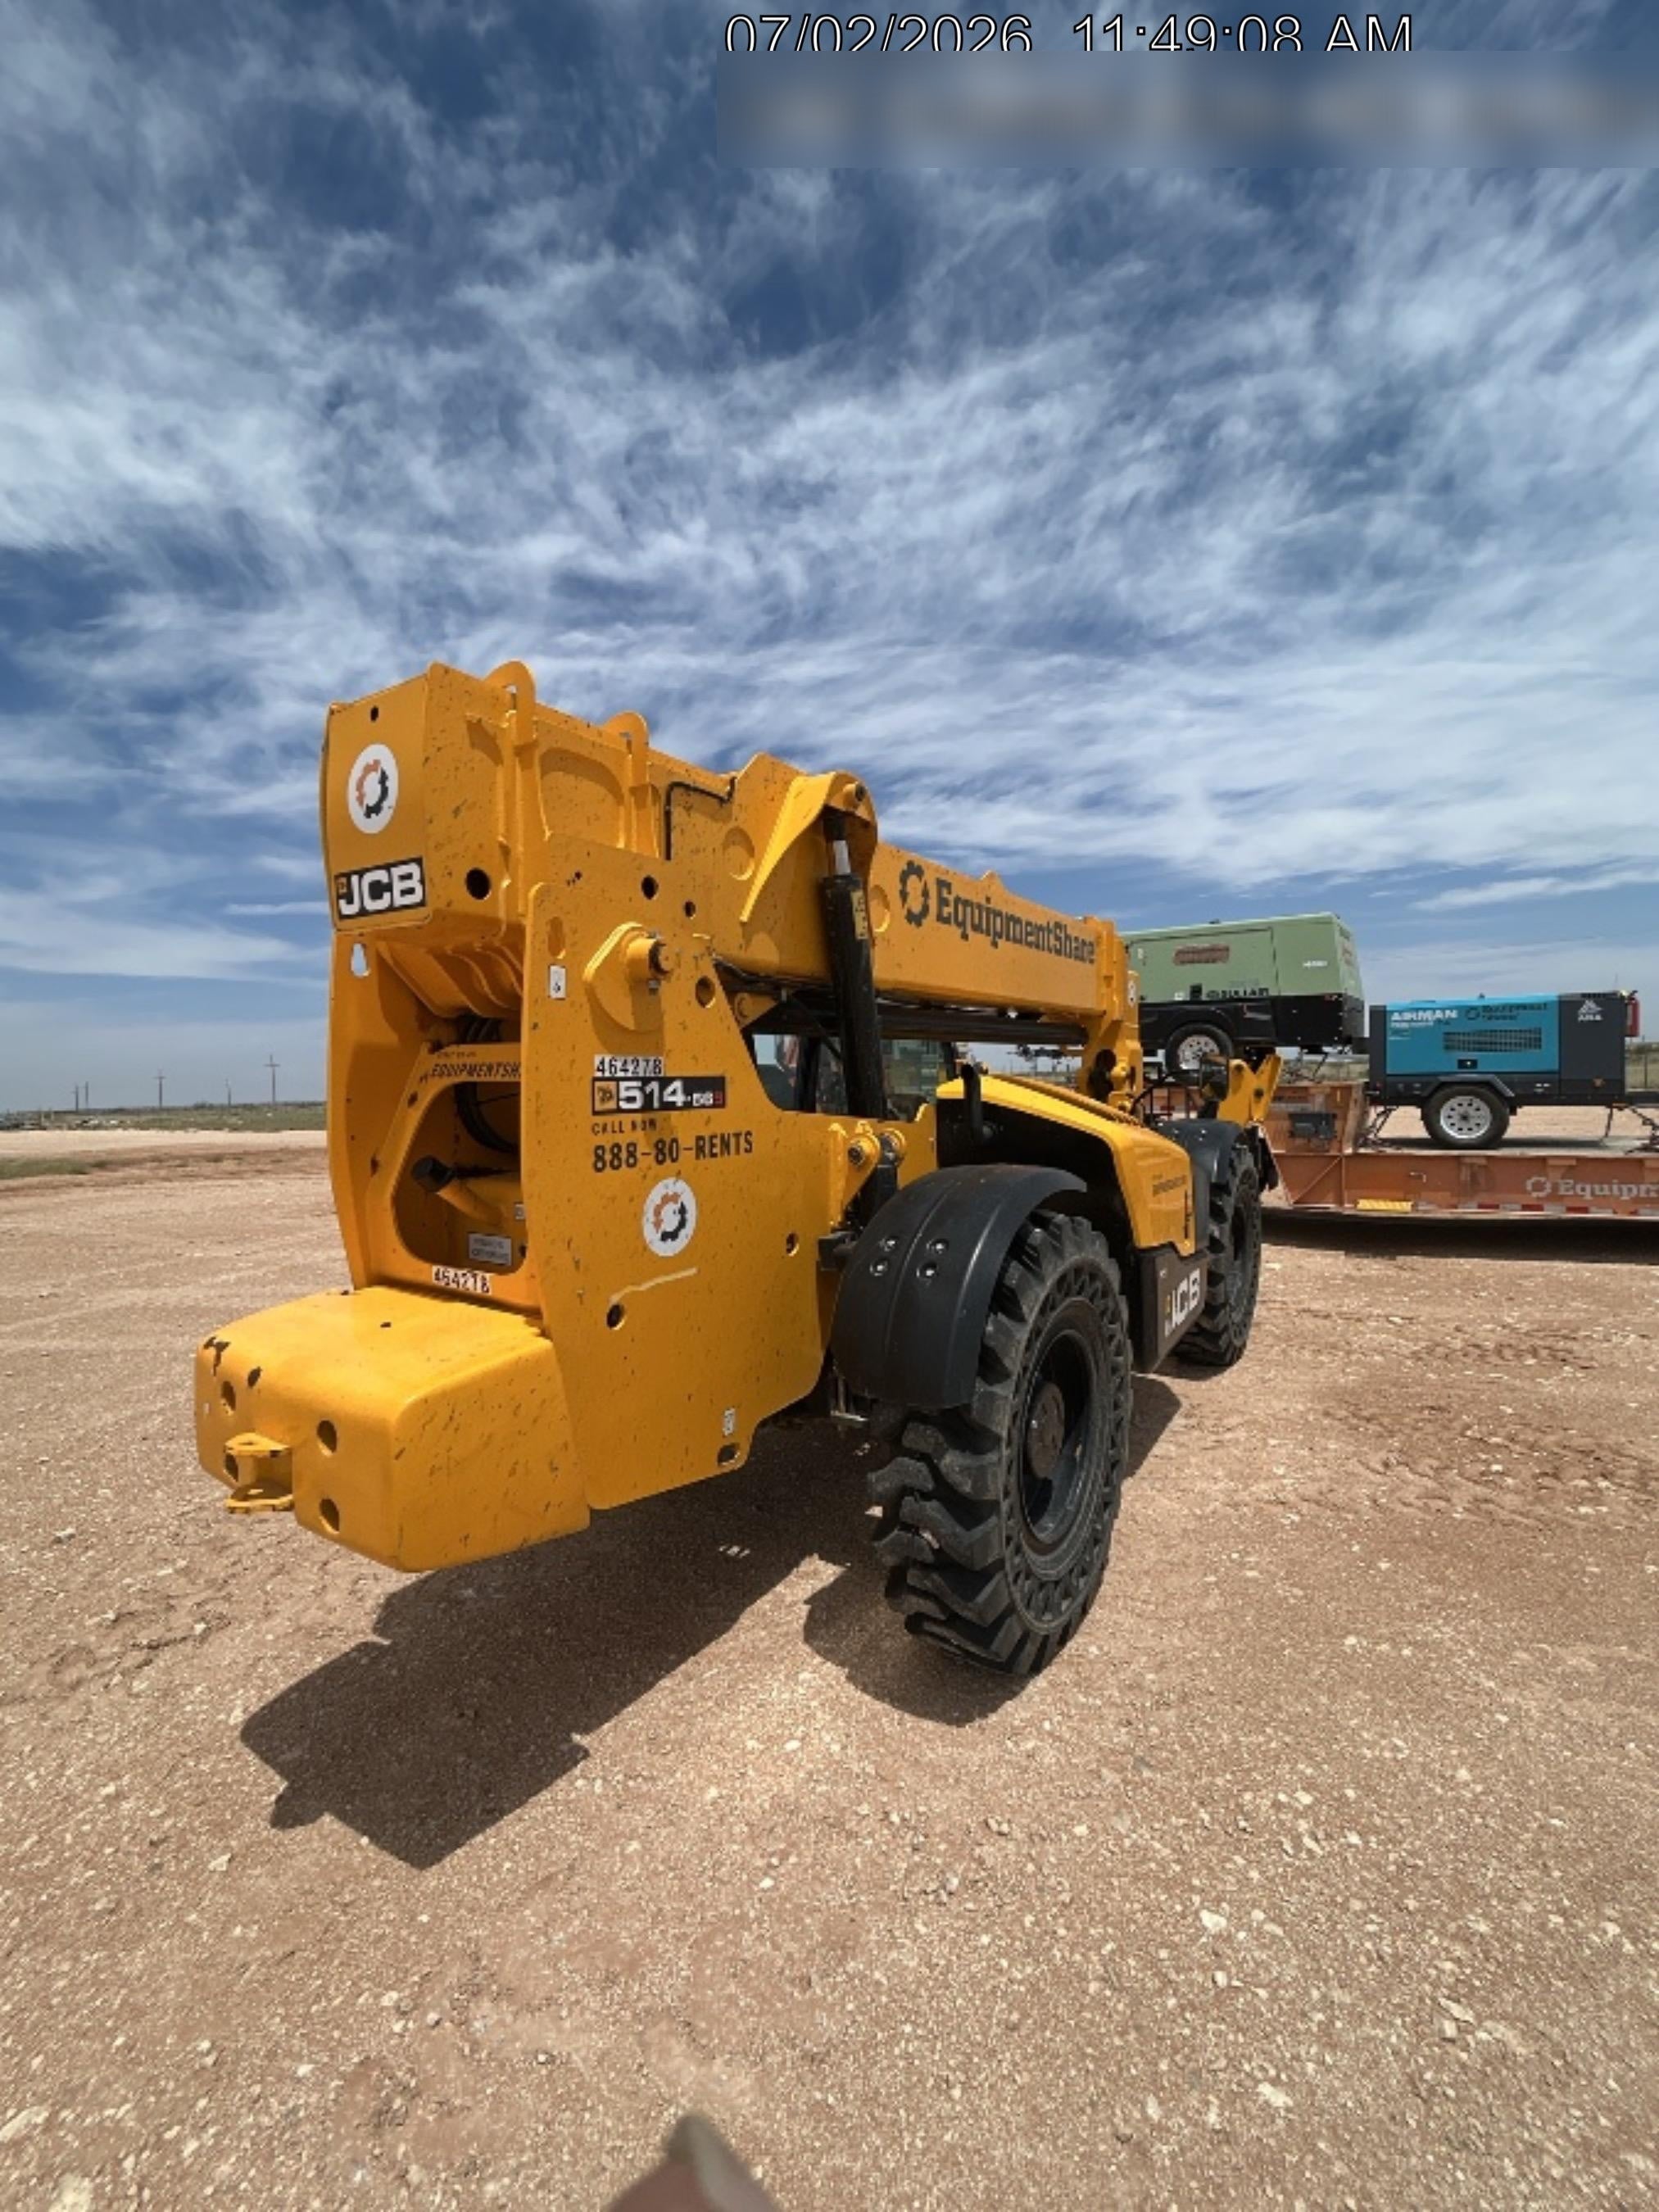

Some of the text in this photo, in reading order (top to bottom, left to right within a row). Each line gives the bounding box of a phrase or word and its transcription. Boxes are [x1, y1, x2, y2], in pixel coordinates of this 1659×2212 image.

[338, 862, 424, 916] JCB
[936, 877, 1095, 964] EquipmentShare
[596, 1057, 662, 1077] 464278
[592, 1120, 624, 1135] CALL
[593, 1131, 753, 1172] 888-80-RENTS
[1164, 1268, 1200, 1338] JCB
